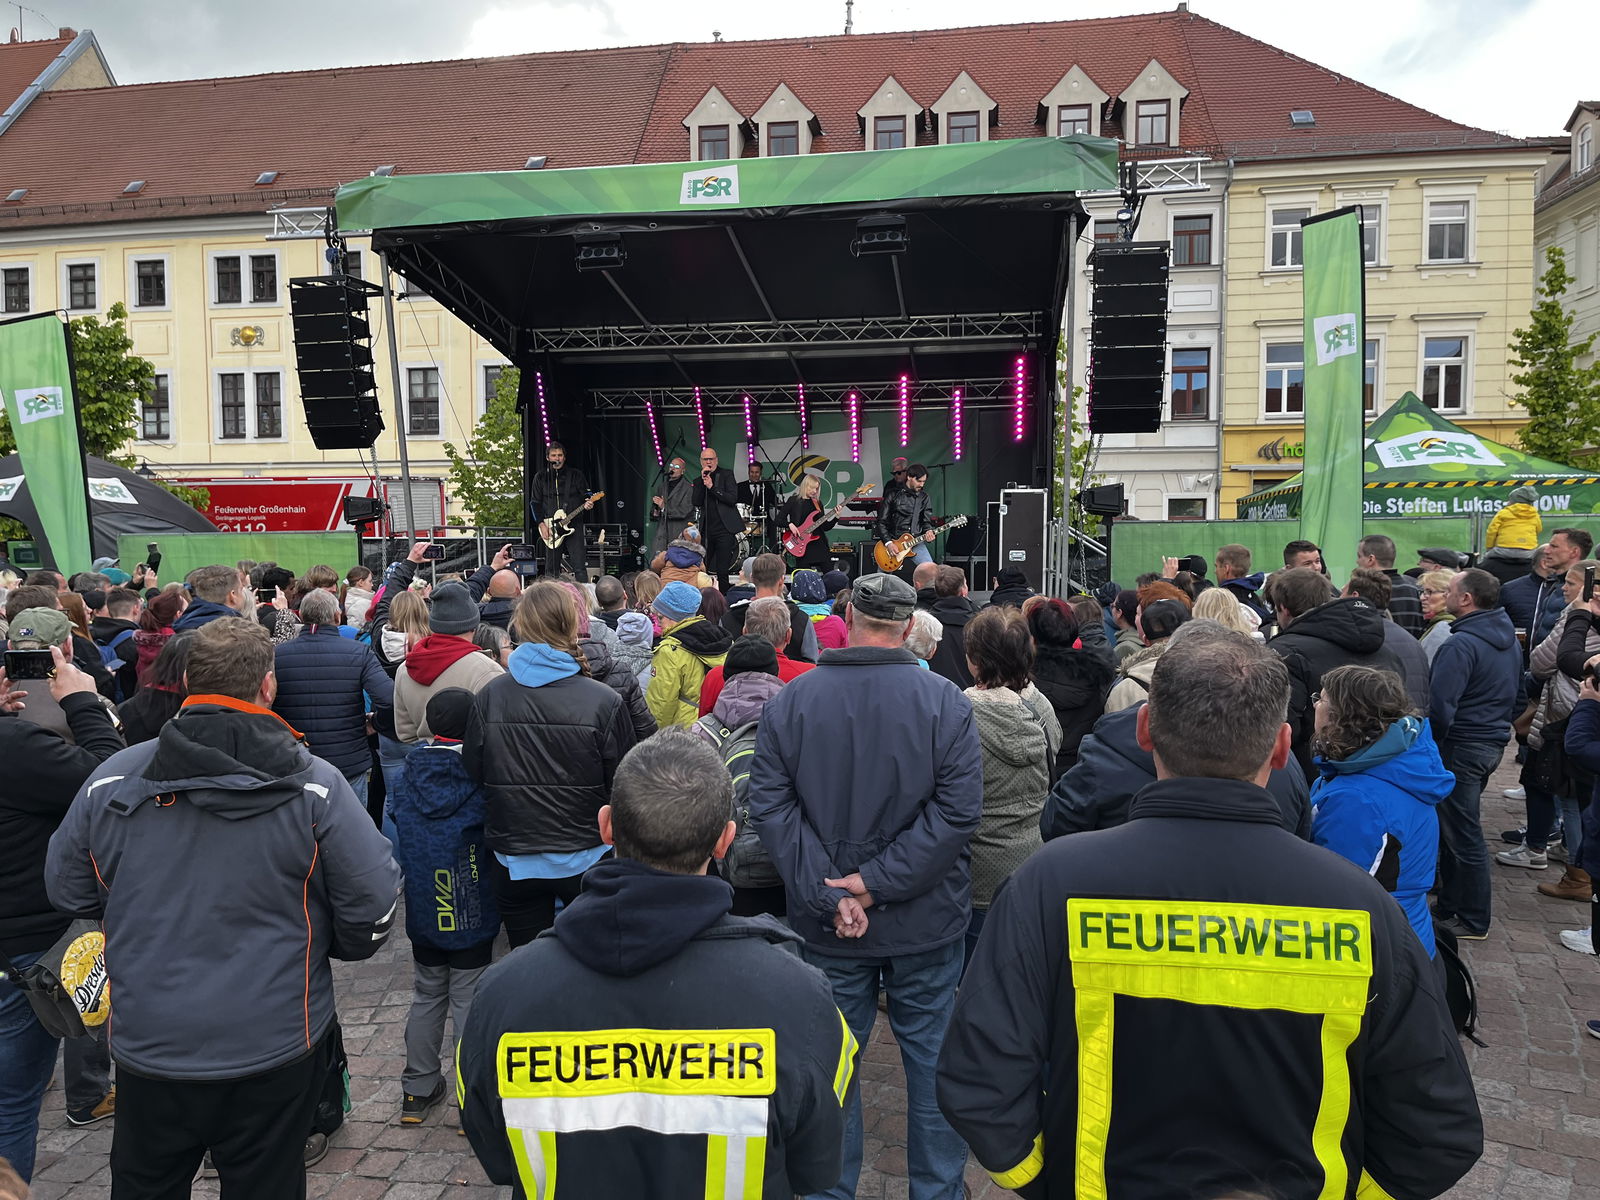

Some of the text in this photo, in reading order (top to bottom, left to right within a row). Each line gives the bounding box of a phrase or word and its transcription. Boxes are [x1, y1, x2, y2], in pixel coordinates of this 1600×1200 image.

[692, 176, 732, 198] PSR
[1397, 437, 1484, 461] PSR
[214, 505, 306, 514] Feuerwehr Großenhain
[1363, 494, 1571, 514] Die Steffen Lukas-OW
[233, 522, 266, 532] 112
[1079, 911, 1361, 963] FEUERWEHR
[74, 948, 105, 1013] Dresde
[506, 1042, 764, 1083] FEUERWEHR
